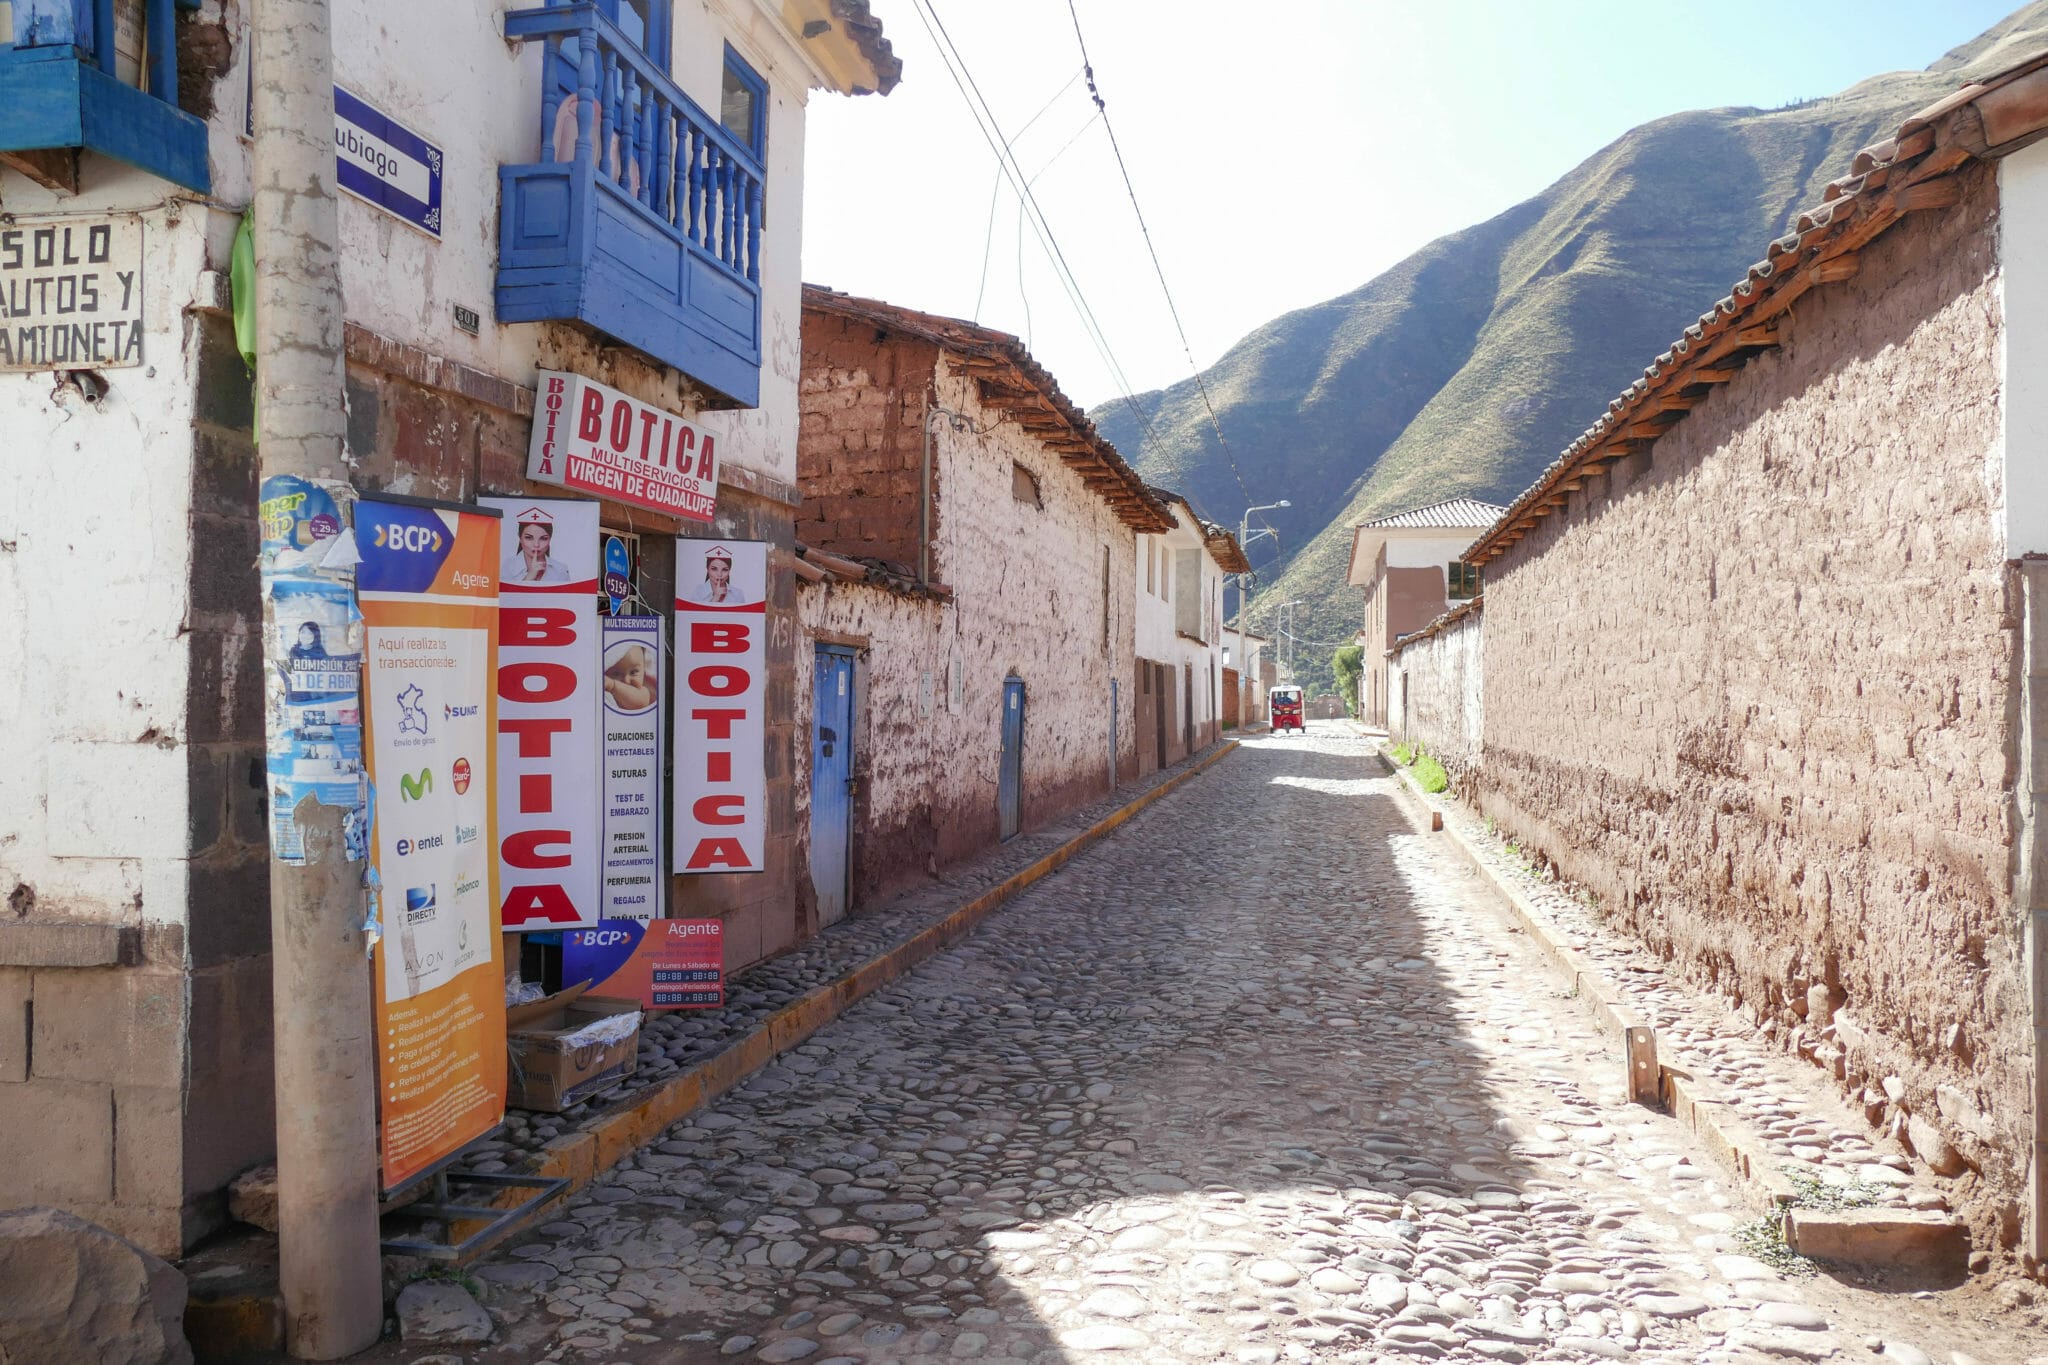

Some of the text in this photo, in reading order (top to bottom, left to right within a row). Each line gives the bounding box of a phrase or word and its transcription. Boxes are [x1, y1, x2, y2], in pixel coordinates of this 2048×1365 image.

[335, 127, 398, 177] ubiaga
[2, 224, 111, 270] SOLO
[116, 271, 134, 311] Y
[0, 319, 144, 365] AMIONETA
[538, 377, 565, 475] BOTICA
[578, 385, 715, 482] BOTICA
[591, 447, 700, 492] MULTISERVICIOS
[570, 458, 713, 517] VIRGEN DE GUADALUPE
[260, 492, 307, 519] uper
[388, 523, 431, 552] BCP
[604, 618, 657, 629] MULTISERVICIOS
[378, 637, 404, 652] Aquí
[408, 637, 438, 650] realiza
[306, 673, 324, 689] DE
[452, 705, 478, 717] SUNAT
[607, 732, 655, 742] CURACIONES
[607, 748, 655, 757] INYECTABLES
[685, 622, 753, 870] BOTICA
[498, 607, 582, 926] BOTICA
[611, 769, 648, 779] SUTURAS
[615, 793, 645, 803] TEST DE
[610, 807, 650, 817] EMBARAZO
[418, 834, 443, 850] entel
[613, 832, 645, 841] PRESION
[613, 845, 649, 854] ARTERIAL
[607, 858, 654, 867] MEDICAMENTOS
[607, 876, 652, 886] PERFUMERIA
[613, 896, 646, 905] REGALOS
[407, 907, 437, 922] DIRECTV
[583, 922, 720, 946] BCP Agente
[405, 949, 444, 972] AVON
[687, 961, 709, 970] Sábado
[398, 1064, 409, 1074] de
